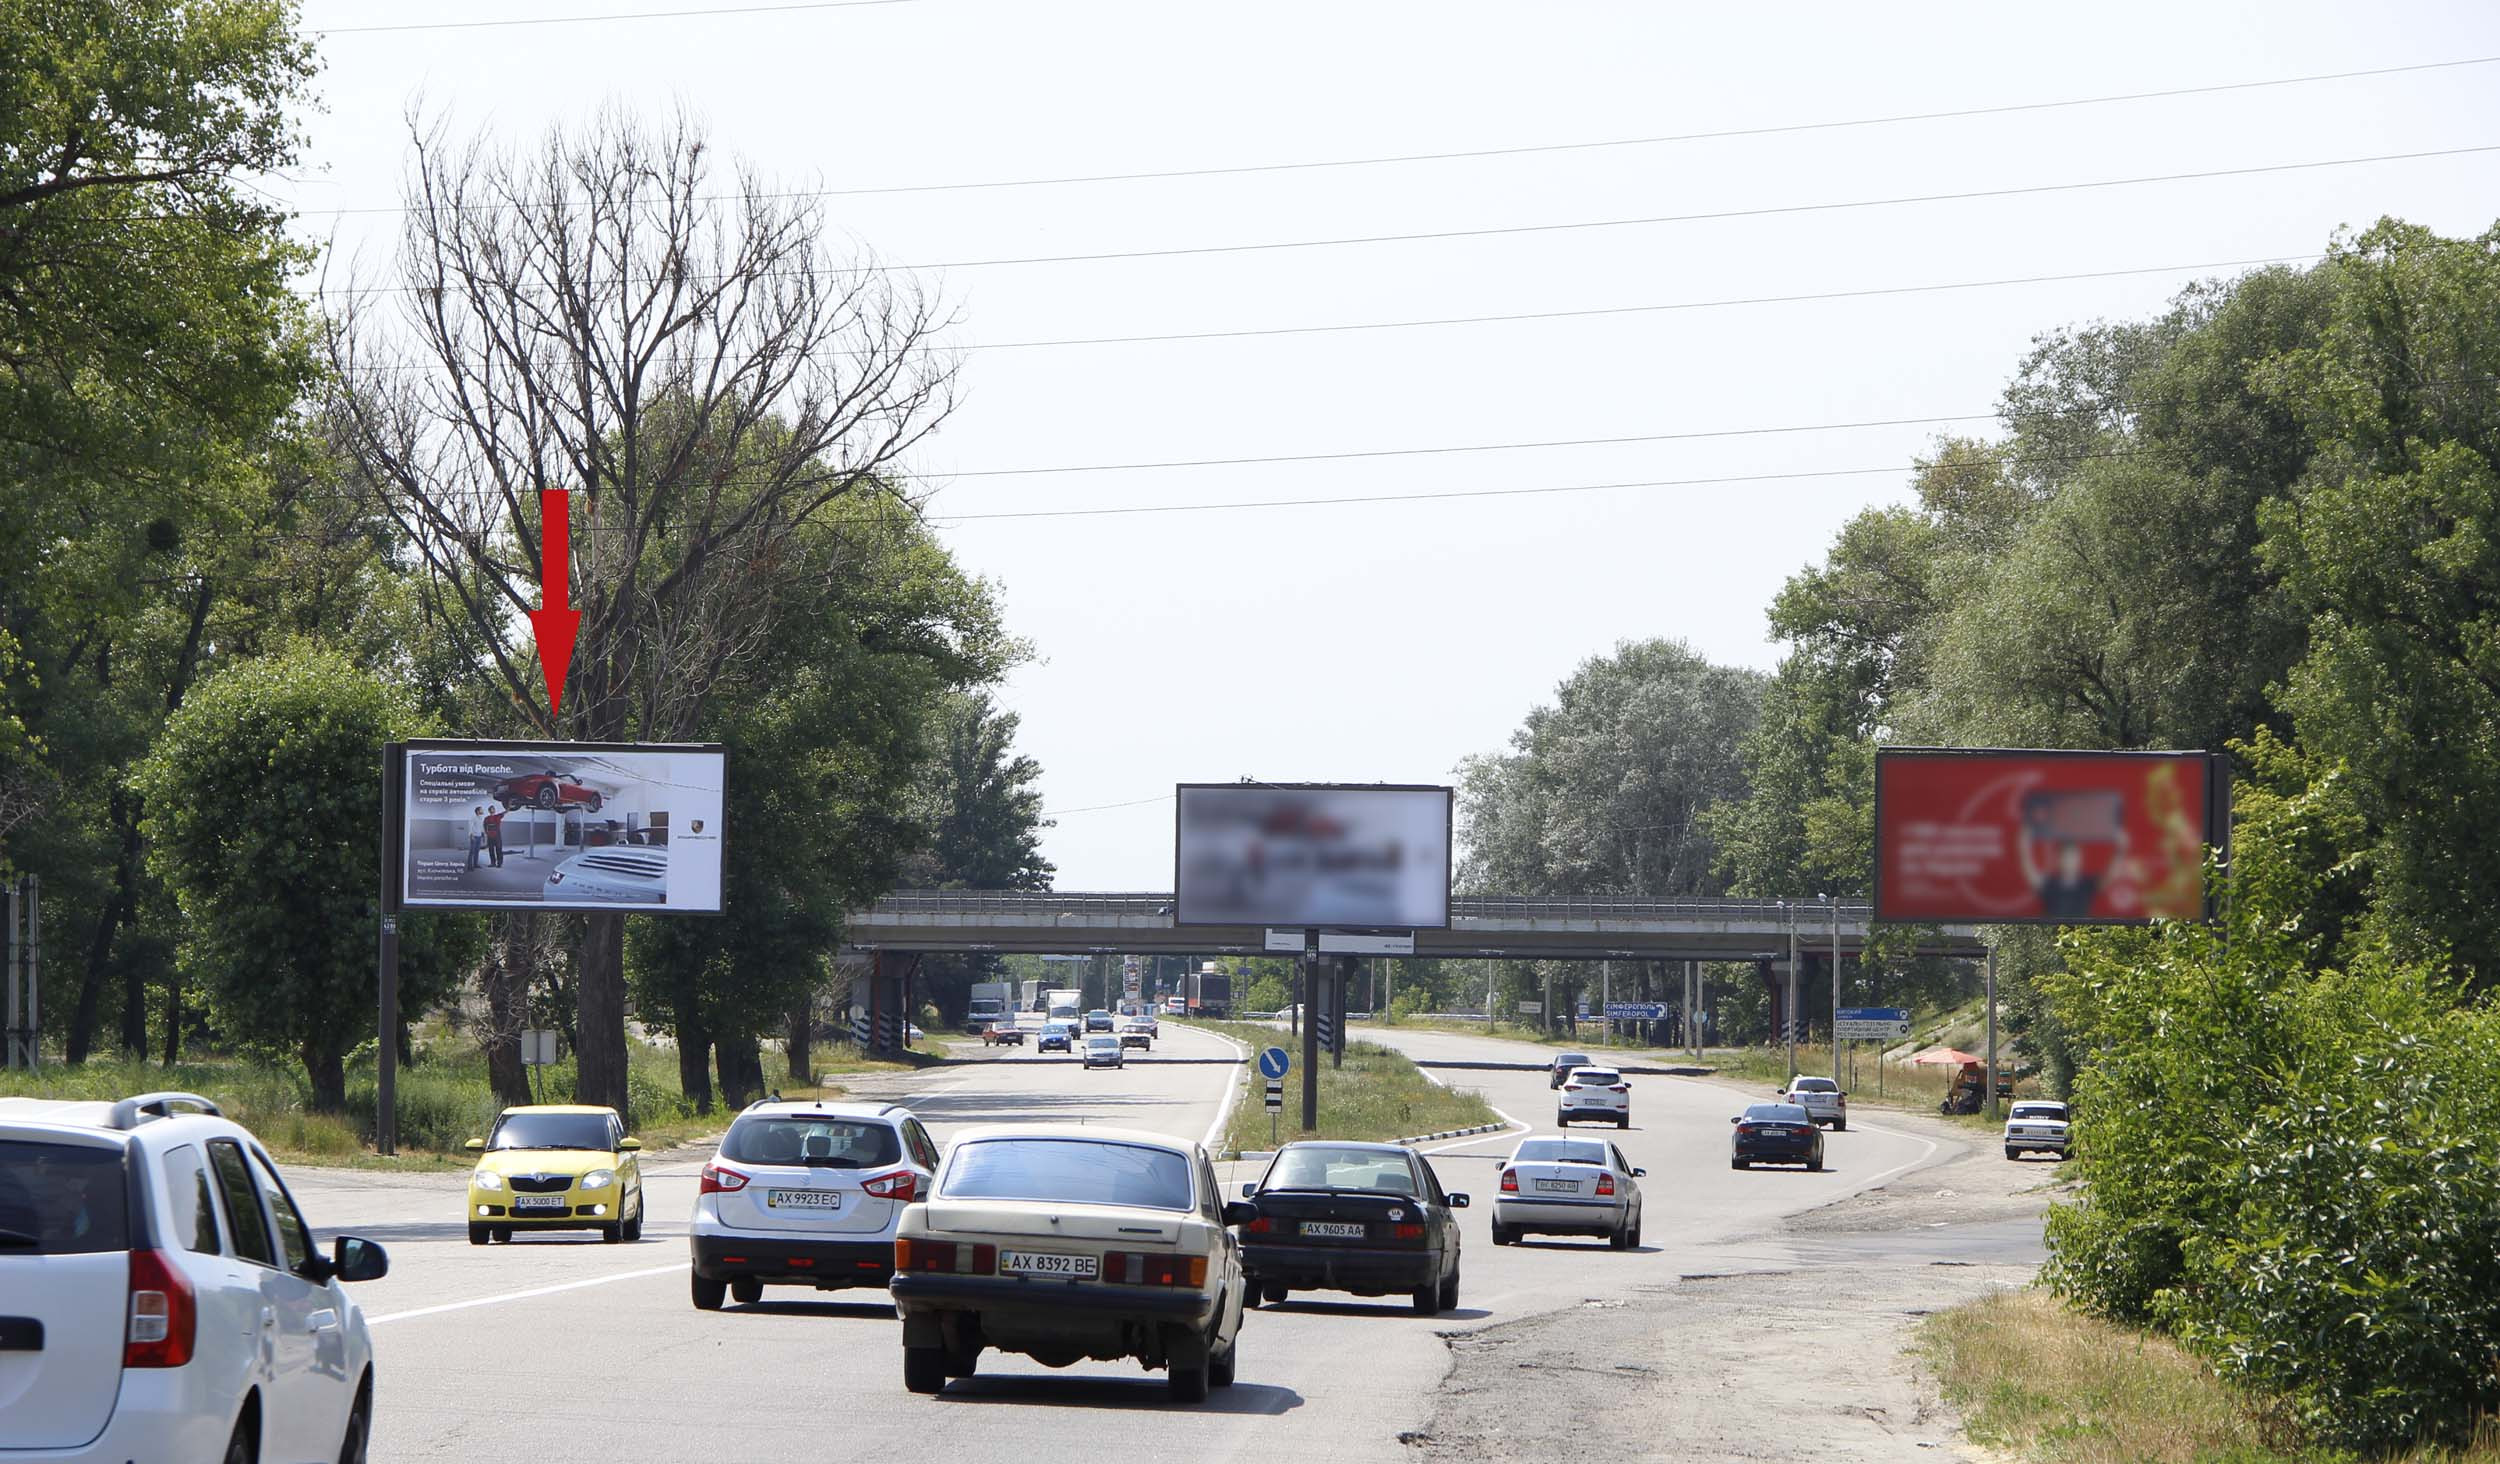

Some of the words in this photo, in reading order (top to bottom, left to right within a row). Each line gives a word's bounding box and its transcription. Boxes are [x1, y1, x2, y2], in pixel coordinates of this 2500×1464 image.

[420, 763, 458, 775] Турбота
[459, 763, 474, 774] від
[475, 764, 513, 774] Porsche.
[521, 1197, 531, 1205] AX
[776, 1192, 792, 1204] AX
[794, 1193, 819, 1205] 9923
[821, 1194, 838, 1206] EC
[1307, 1223, 1321, 1234] AX
[1323, 1224, 1345, 1235] 9605
[1347, 1225, 1361, 1236] AA
[1011, 1254, 1032, 1270] AX
[1036, 1256, 1070, 1272] 8392
[1074, 1258, 1095, 1273] BE
